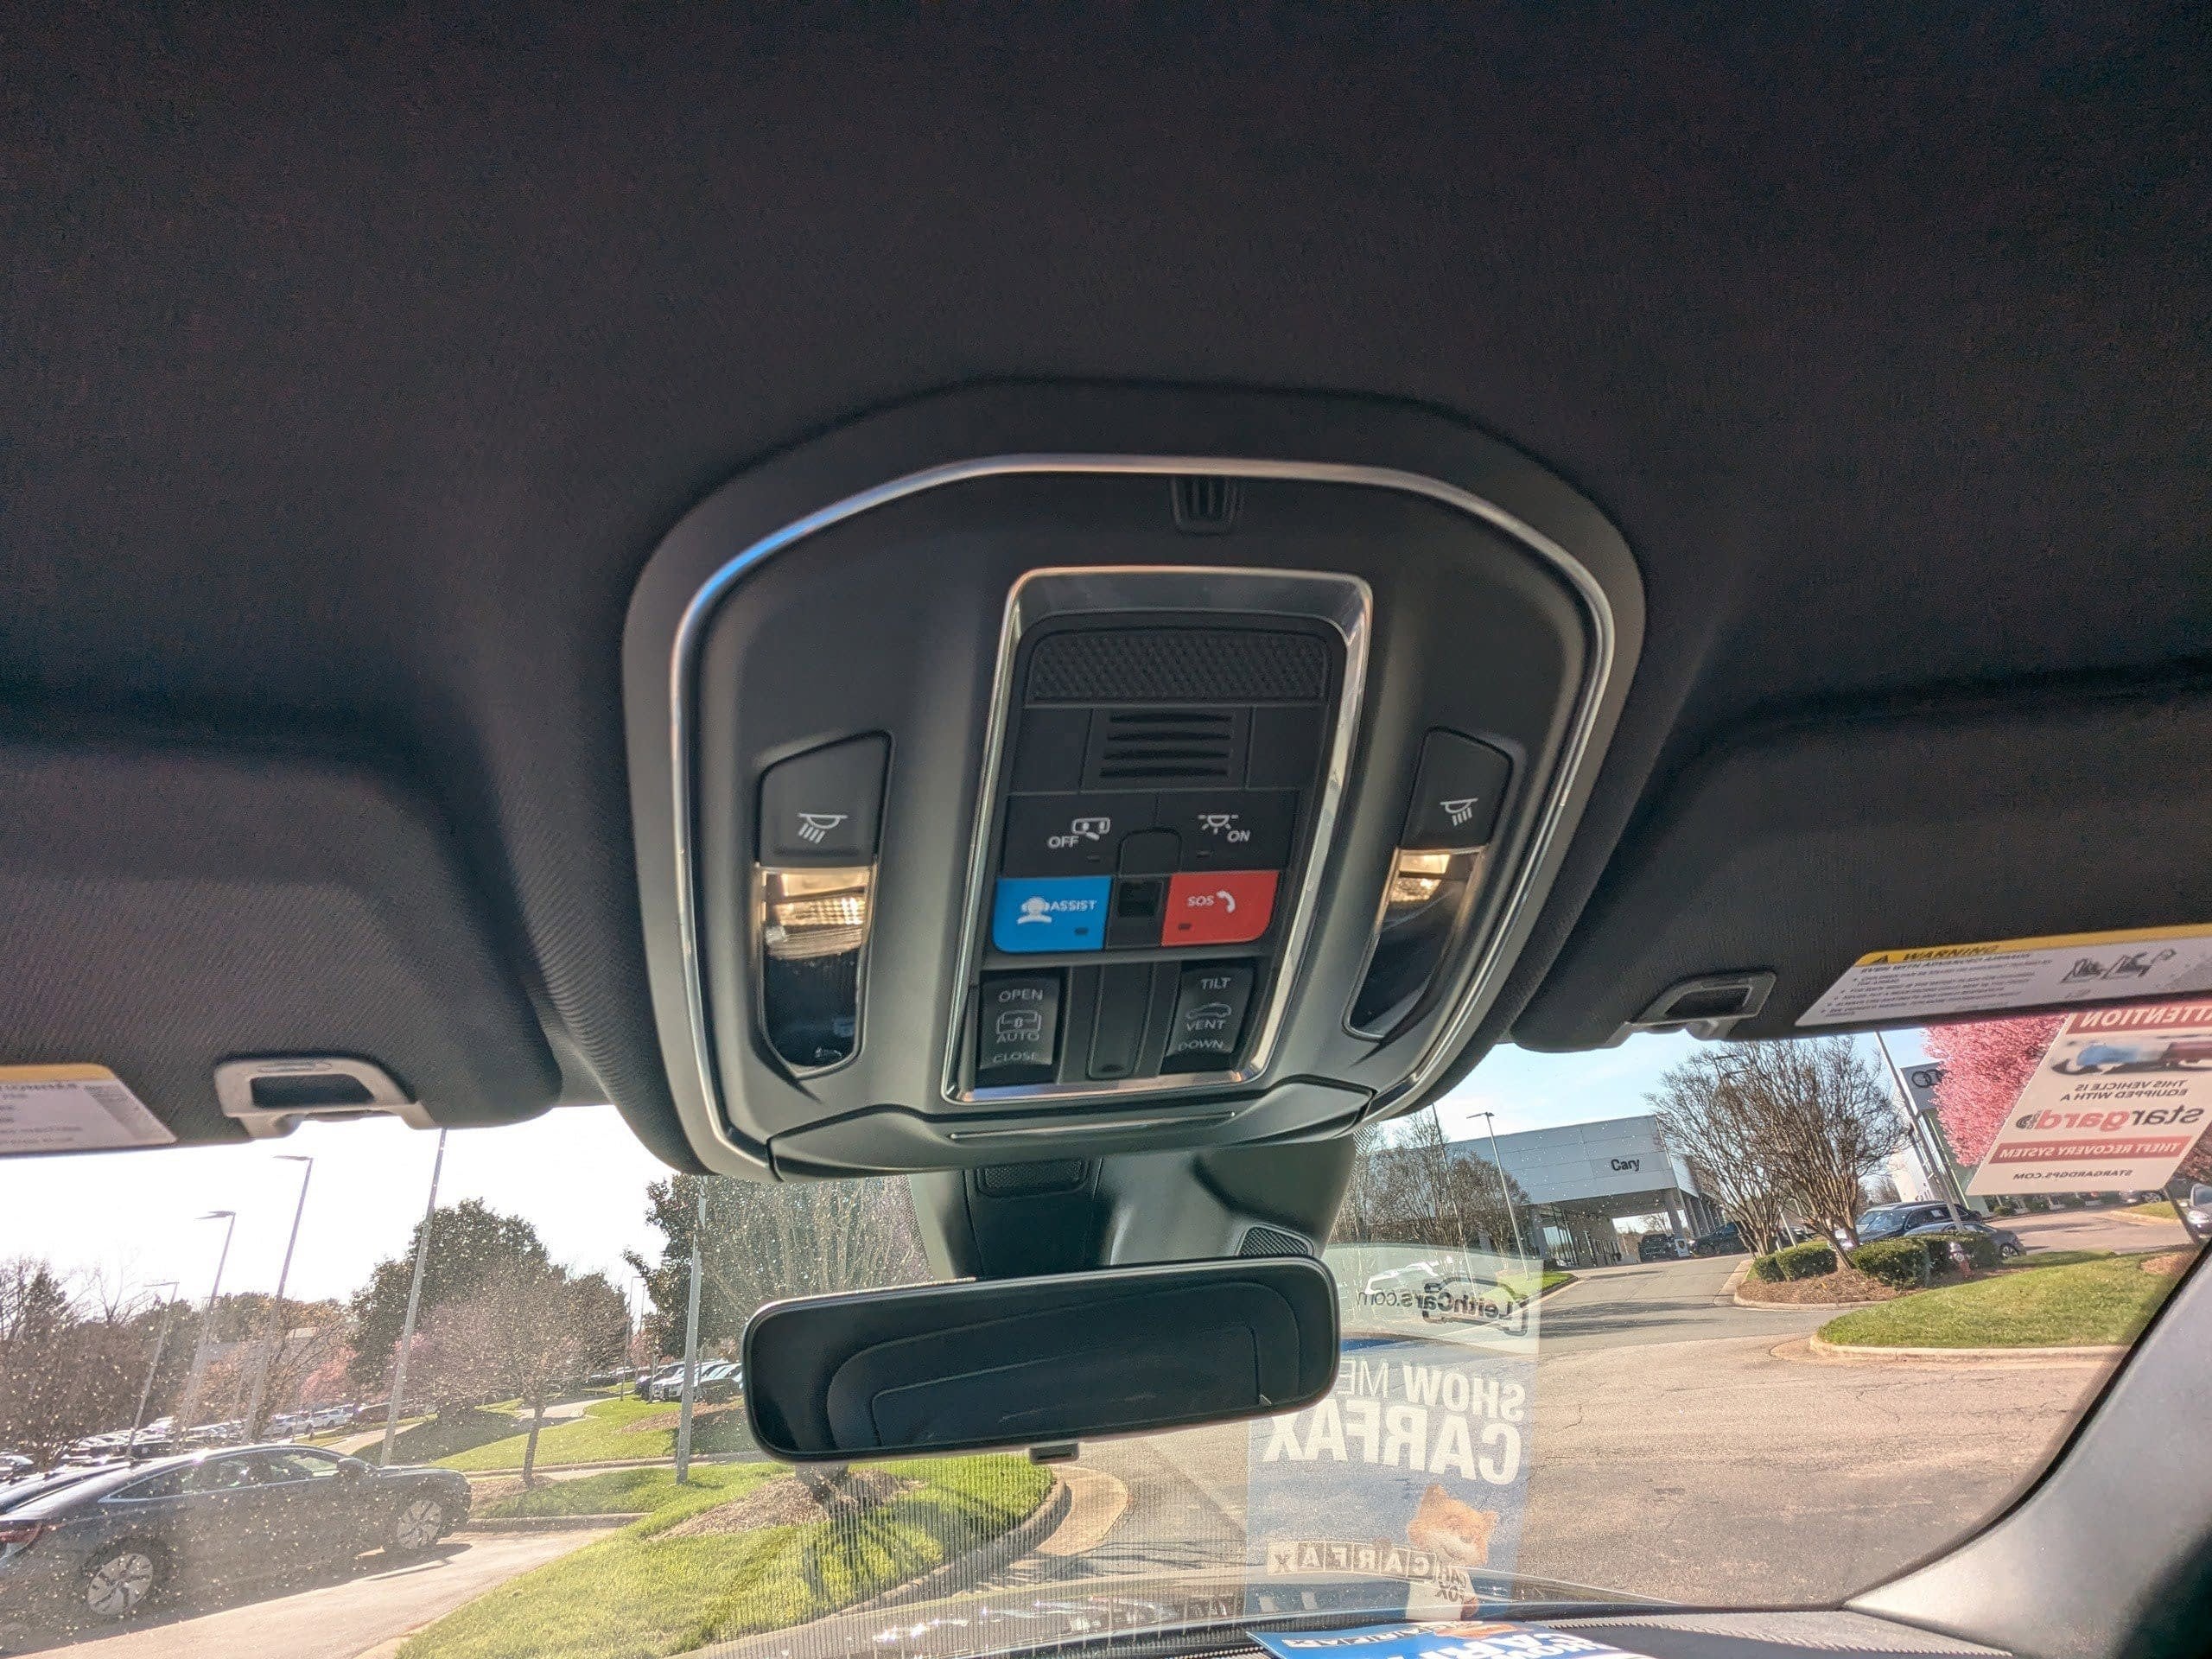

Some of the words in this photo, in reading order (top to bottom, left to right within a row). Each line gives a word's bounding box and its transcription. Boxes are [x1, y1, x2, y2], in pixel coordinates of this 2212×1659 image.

[1047, 835, 1079, 849] OFF
[1227, 830, 1250, 843] ON
[1050, 899, 1097, 912] ASSIST
[1187, 895, 1214, 907] SOS
[1200, 976, 1231, 990] TILT
[999, 988, 1043, 1001] OPEN
[1186, 1019, 1225, 1032] VENT
[996, 1032, 1039, 1044] AUTO
[1178, 1039, 1224, 1052] DOWN
[1611, 1159, 1640, 1172] Cary
